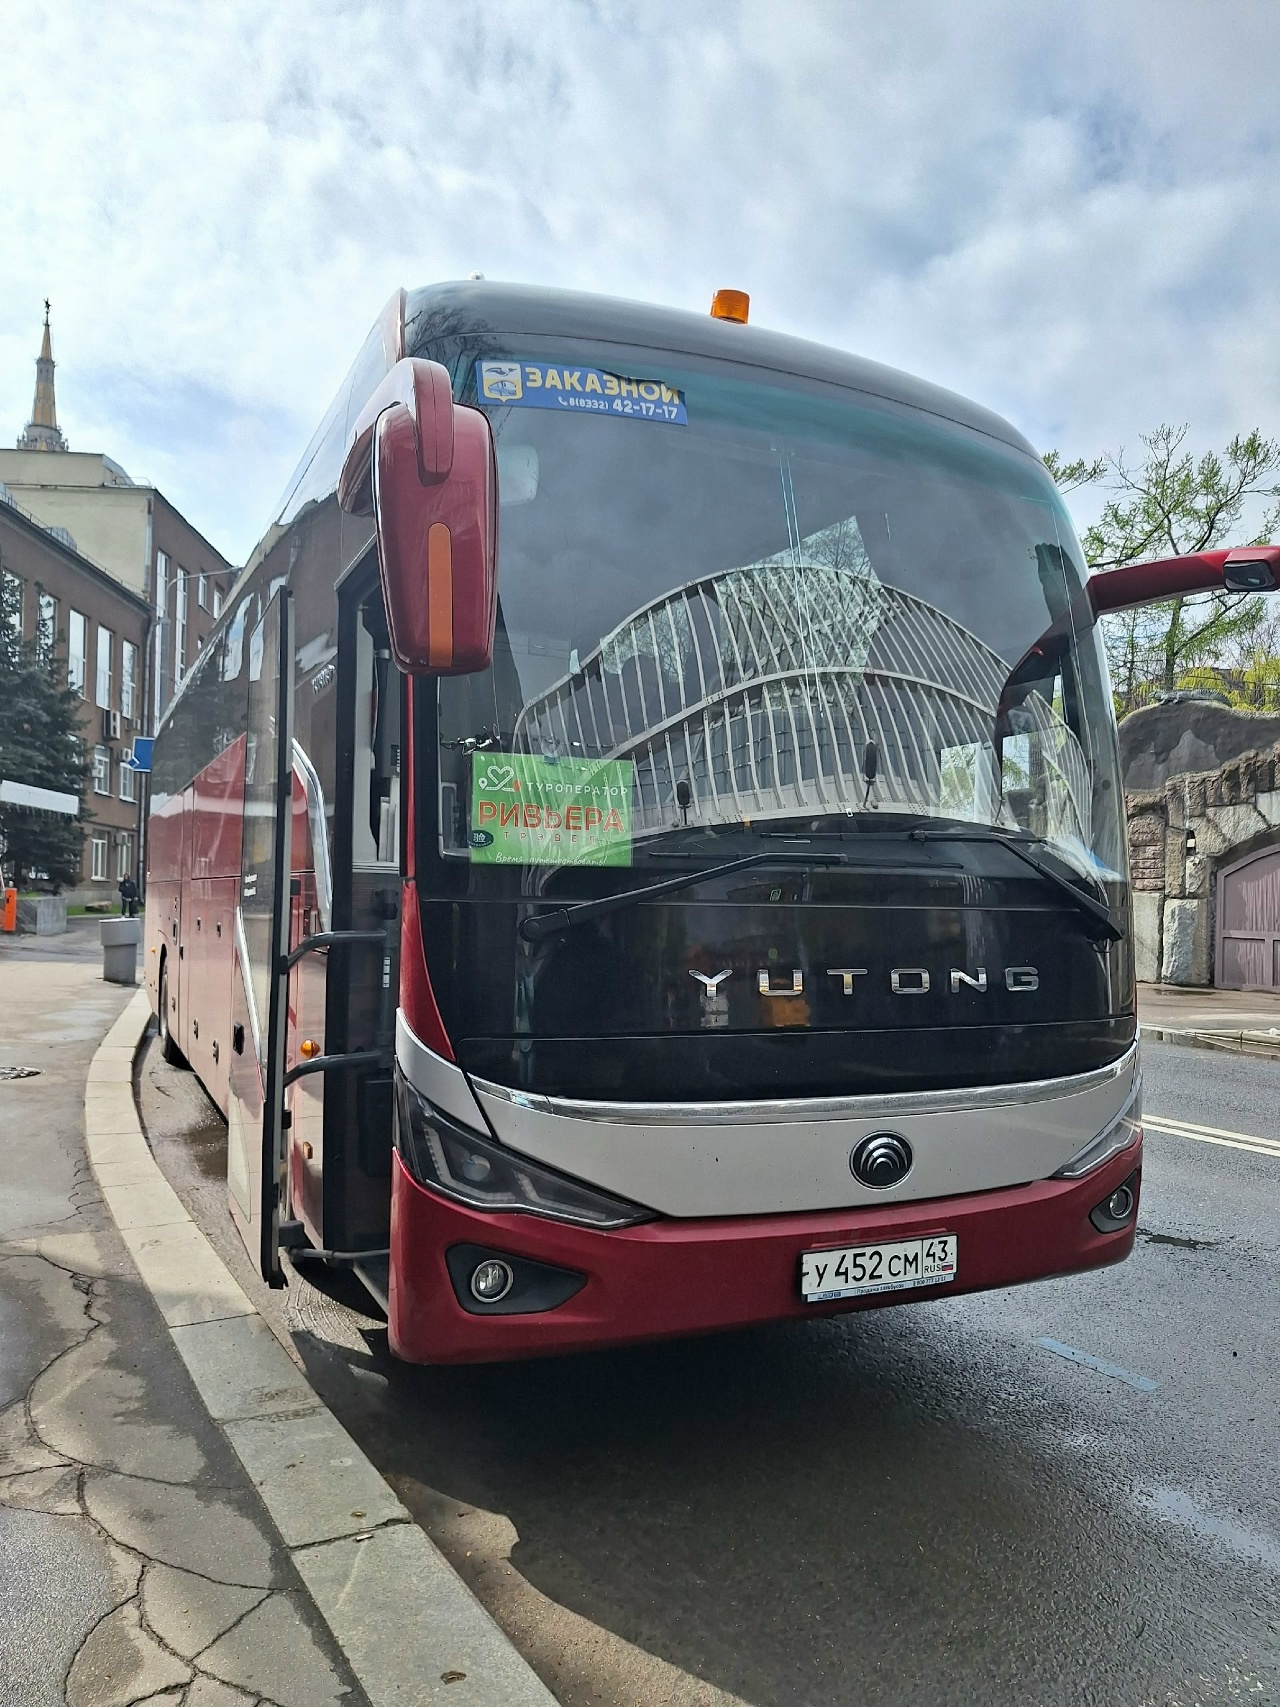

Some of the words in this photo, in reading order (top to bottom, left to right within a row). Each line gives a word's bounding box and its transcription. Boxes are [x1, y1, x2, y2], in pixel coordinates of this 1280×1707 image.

[569, 397, 609, 410] 8(8332)
[612, 399, 678, 419] 42-17-17
[526, 782, 628, 796] ТУРОПЕРАТОР
[478, 800, 625, 833] РИВЬЕРА
[503, 831, 596, 844] ТРЭВЕЛ
[495, 852, 524, 864] Время
[688, 966, 1040, 997] YUTONG
[925, 1239, 949, 1264] 43
[924, 1264, 942, 1274] RUS
